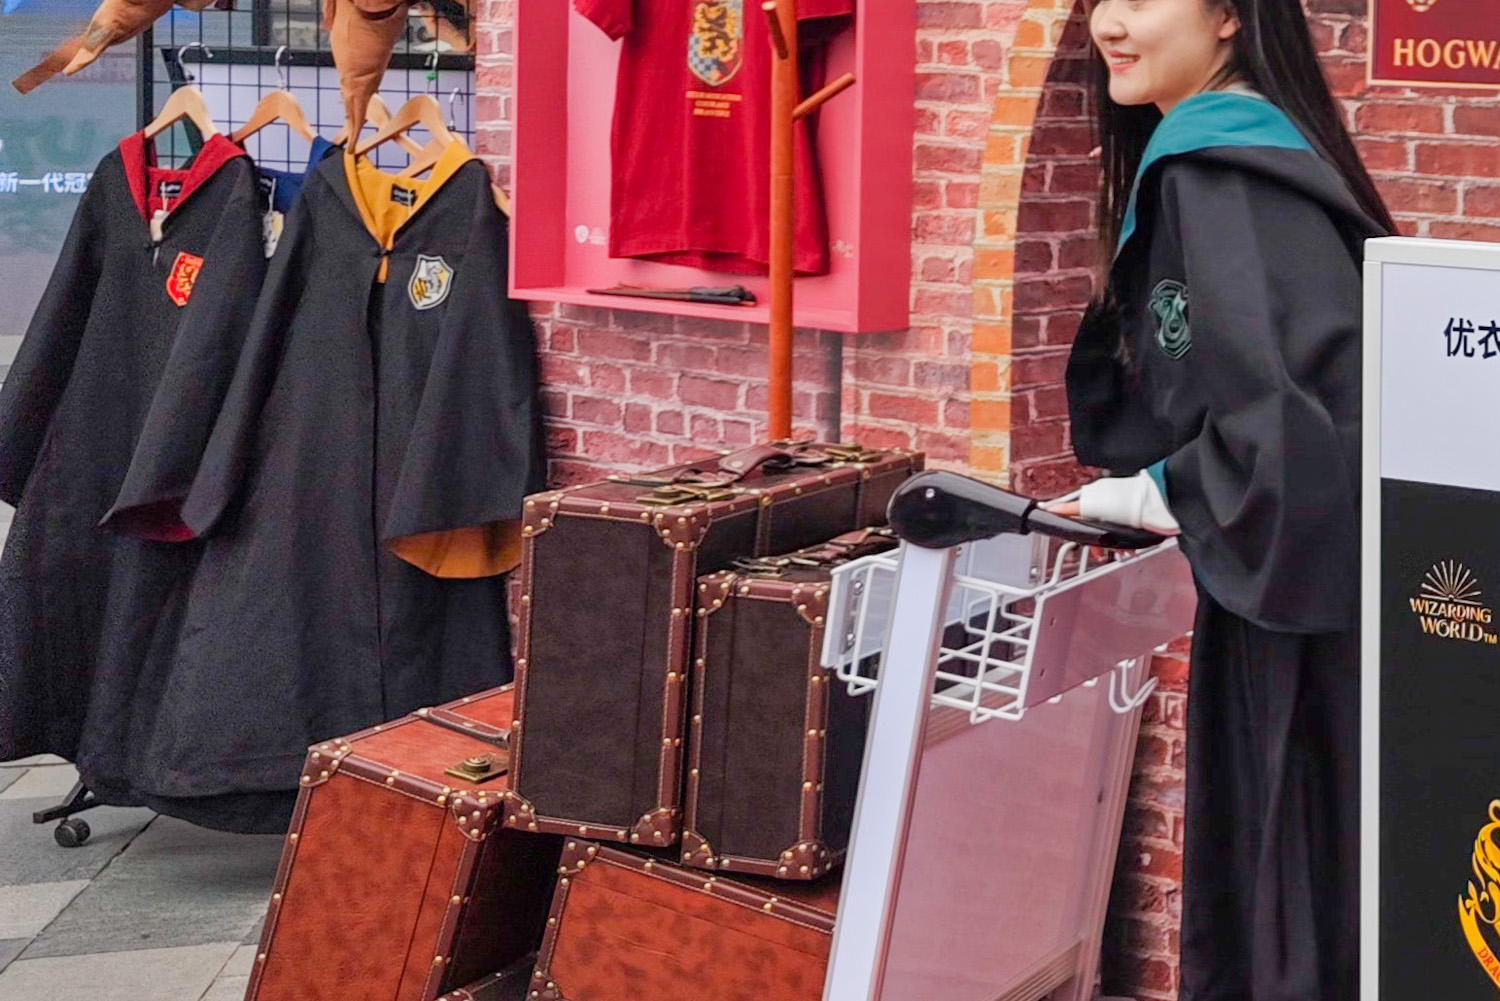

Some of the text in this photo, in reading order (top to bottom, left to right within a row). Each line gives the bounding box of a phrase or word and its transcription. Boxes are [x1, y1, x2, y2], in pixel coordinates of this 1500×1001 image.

[0, 171, 93, 194] 新一代冠
[1409, 597, 1492, 624] WIZARDING
[1420, 615, 1483, 642] WORLD
